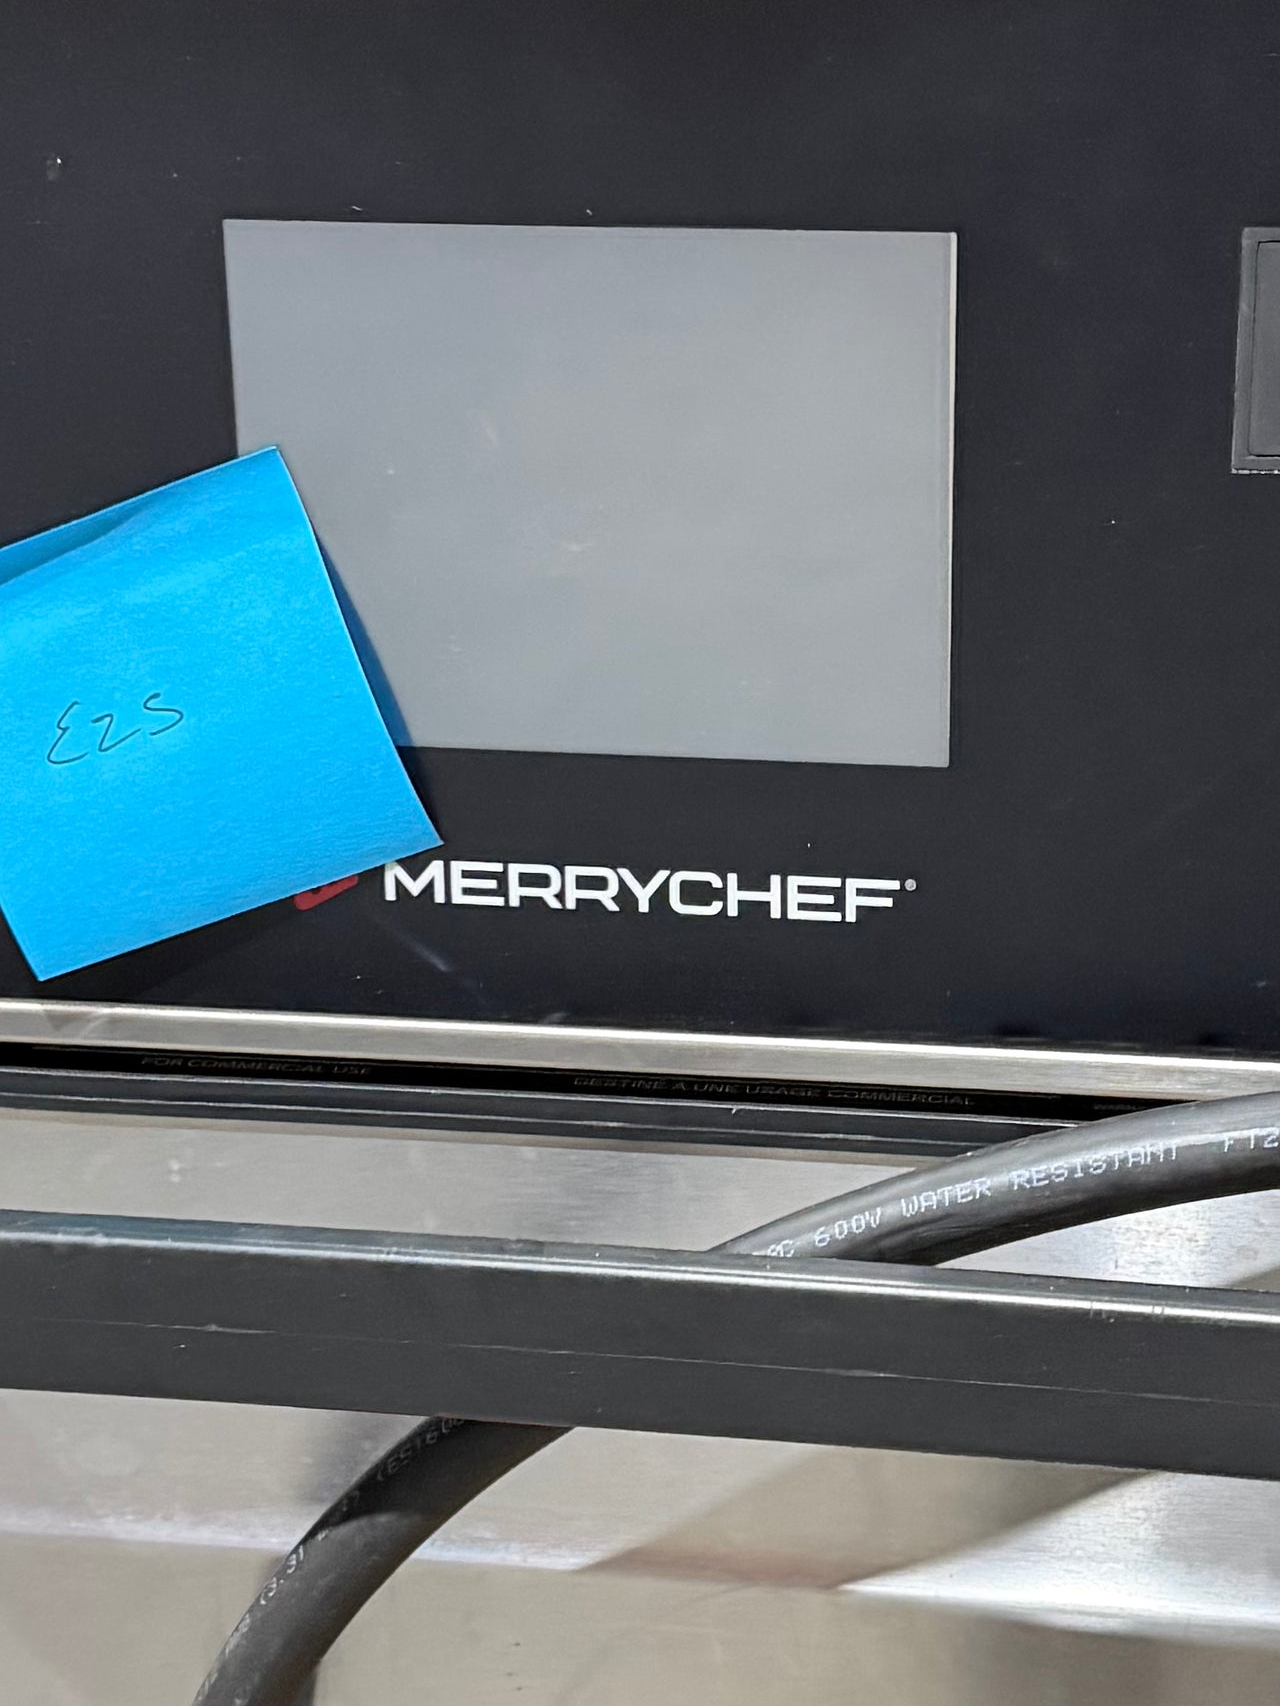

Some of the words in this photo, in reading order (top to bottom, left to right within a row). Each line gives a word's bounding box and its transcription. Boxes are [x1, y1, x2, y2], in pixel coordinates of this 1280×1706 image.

[383, 859, 901, 924] MERRYCHEF
[827, 1089, 976, 1106] COMMERCIAL
[813, 1206, 882, 1247] 600V
[900, 1177, 992, 1217] WATER
[1010, 1139, 1180, 1191] RESISTANT
